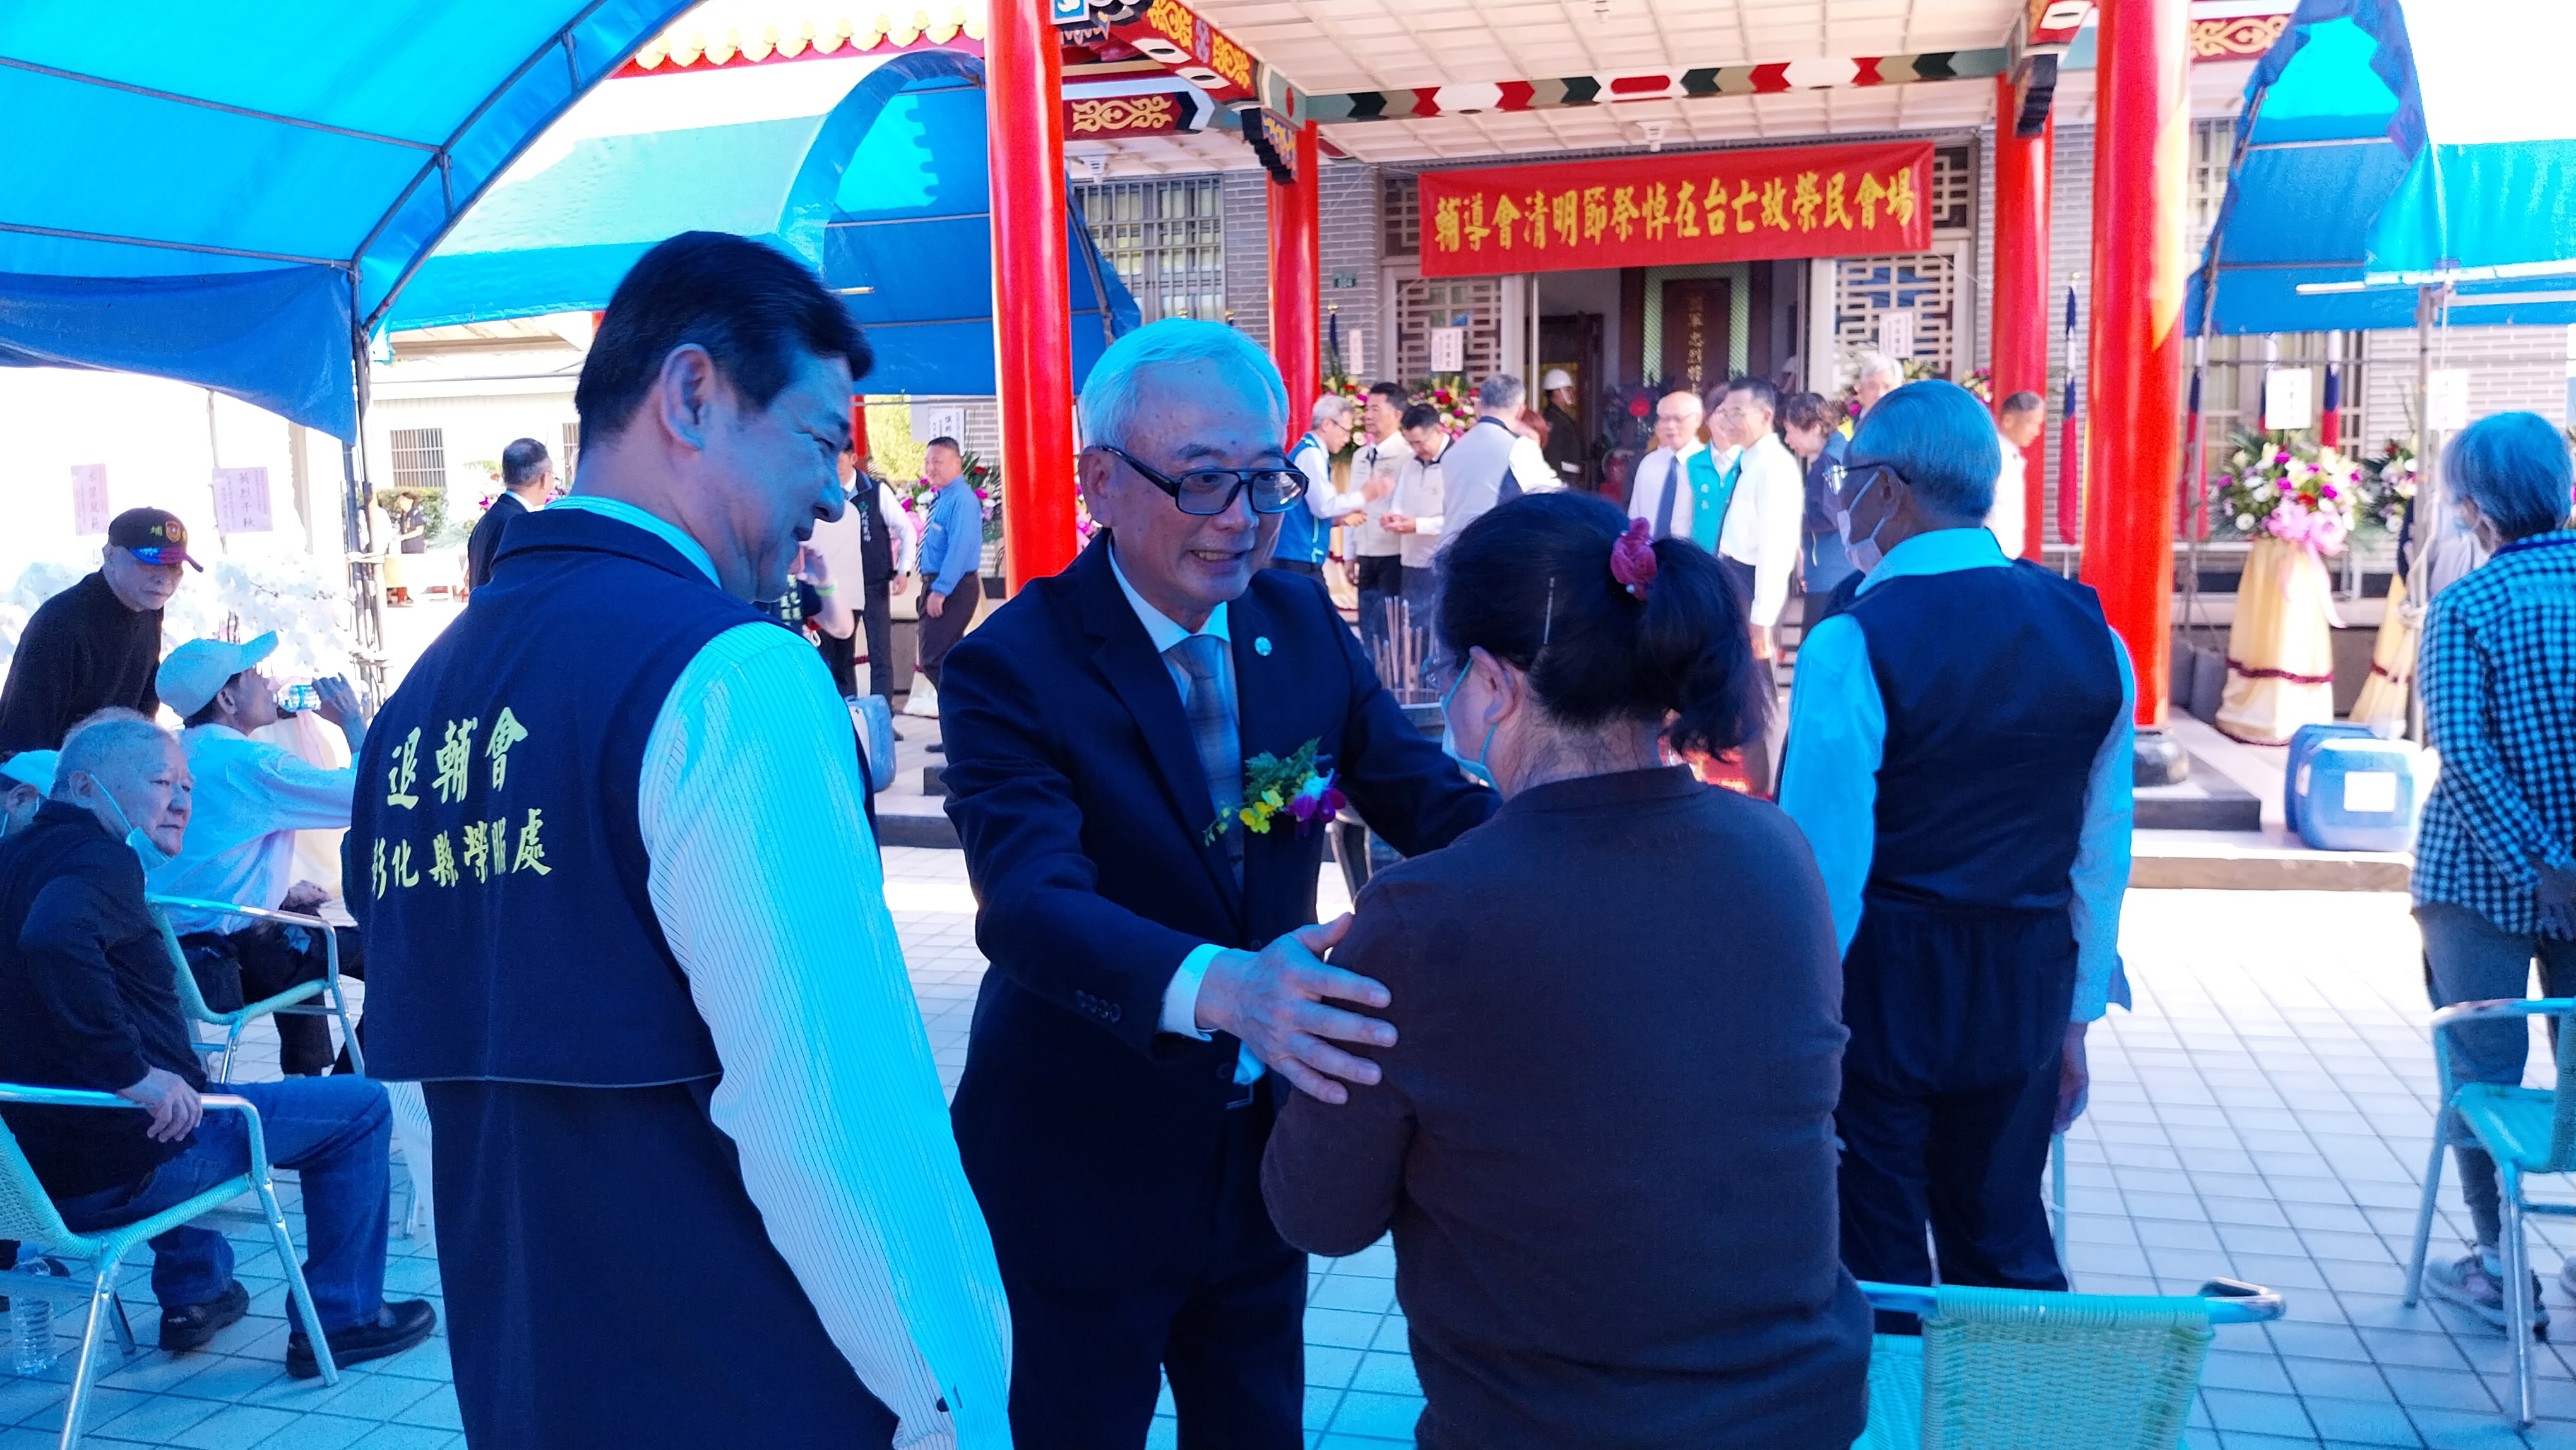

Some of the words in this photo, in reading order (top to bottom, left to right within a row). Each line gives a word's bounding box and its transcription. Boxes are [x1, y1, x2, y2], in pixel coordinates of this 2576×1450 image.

[1434, 166, 1915, 252] 輔導會清明節祭悼在台亡故榮民會場
[239, 471, 255, 528] 英烈千秋
[386, 706, 528, 810] 退輔會
